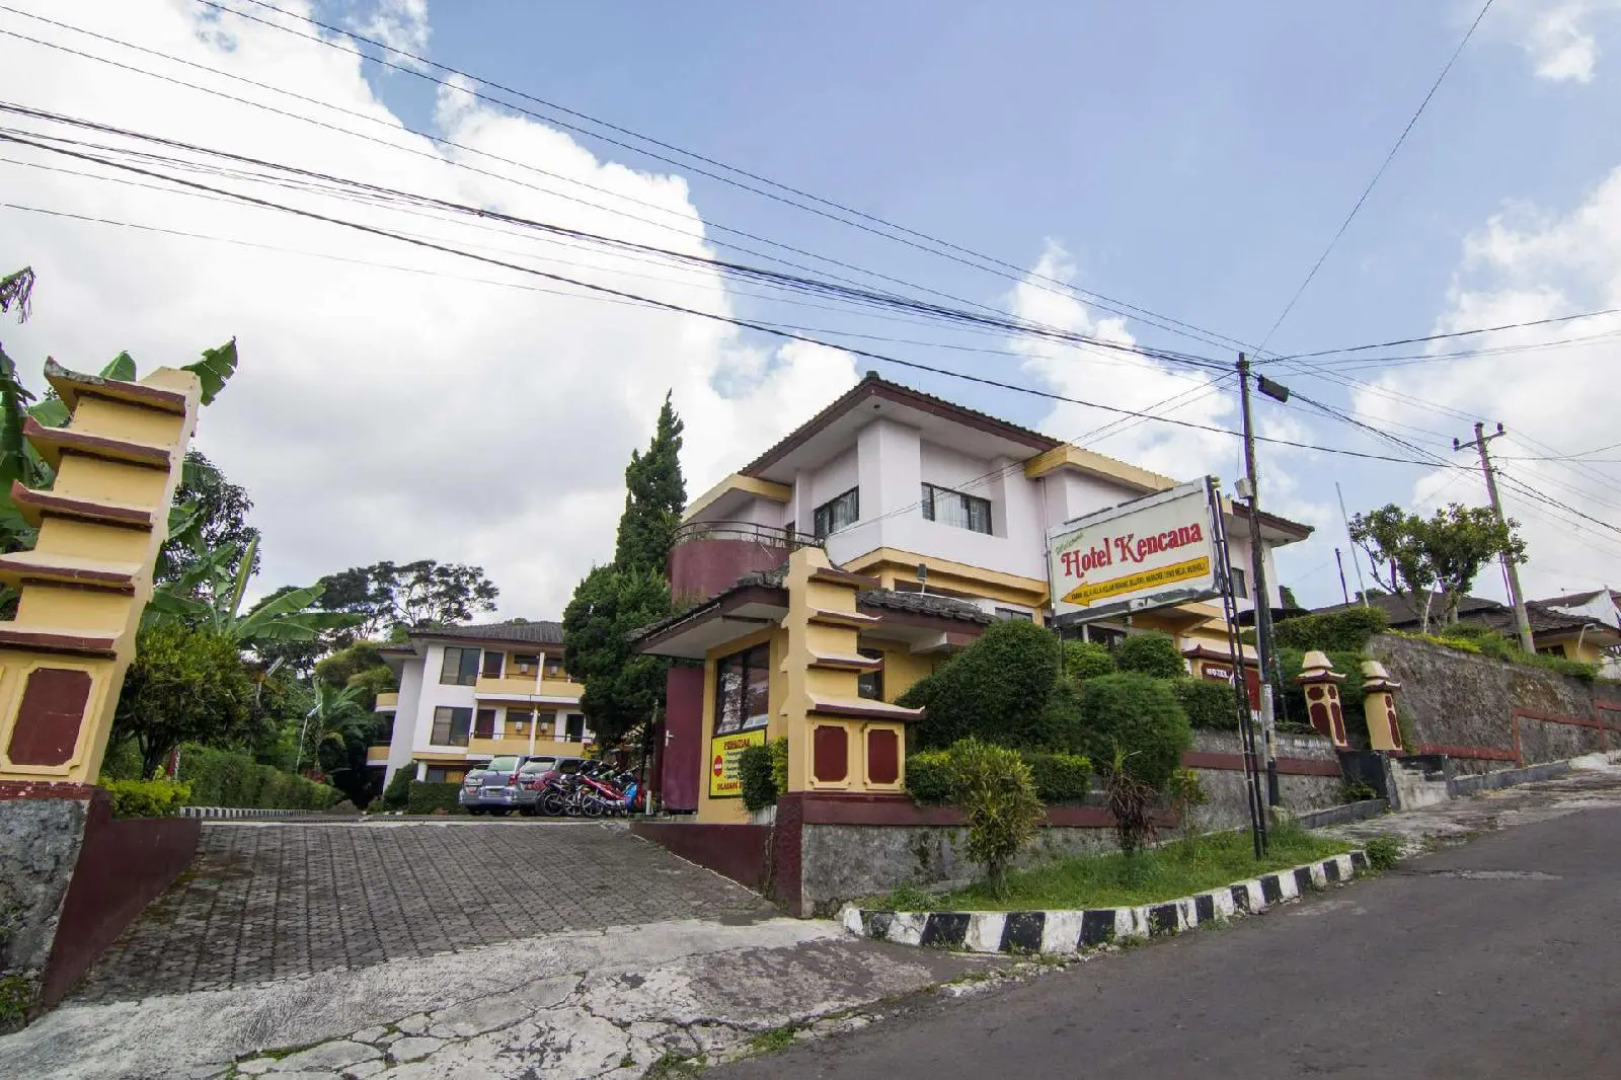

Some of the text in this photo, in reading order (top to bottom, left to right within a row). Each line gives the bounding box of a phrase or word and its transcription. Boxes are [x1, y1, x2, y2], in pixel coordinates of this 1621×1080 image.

[1061, 522, 1203, 578] Hotel Kencana
[1206, 668, 1230, 679] HOTEL
